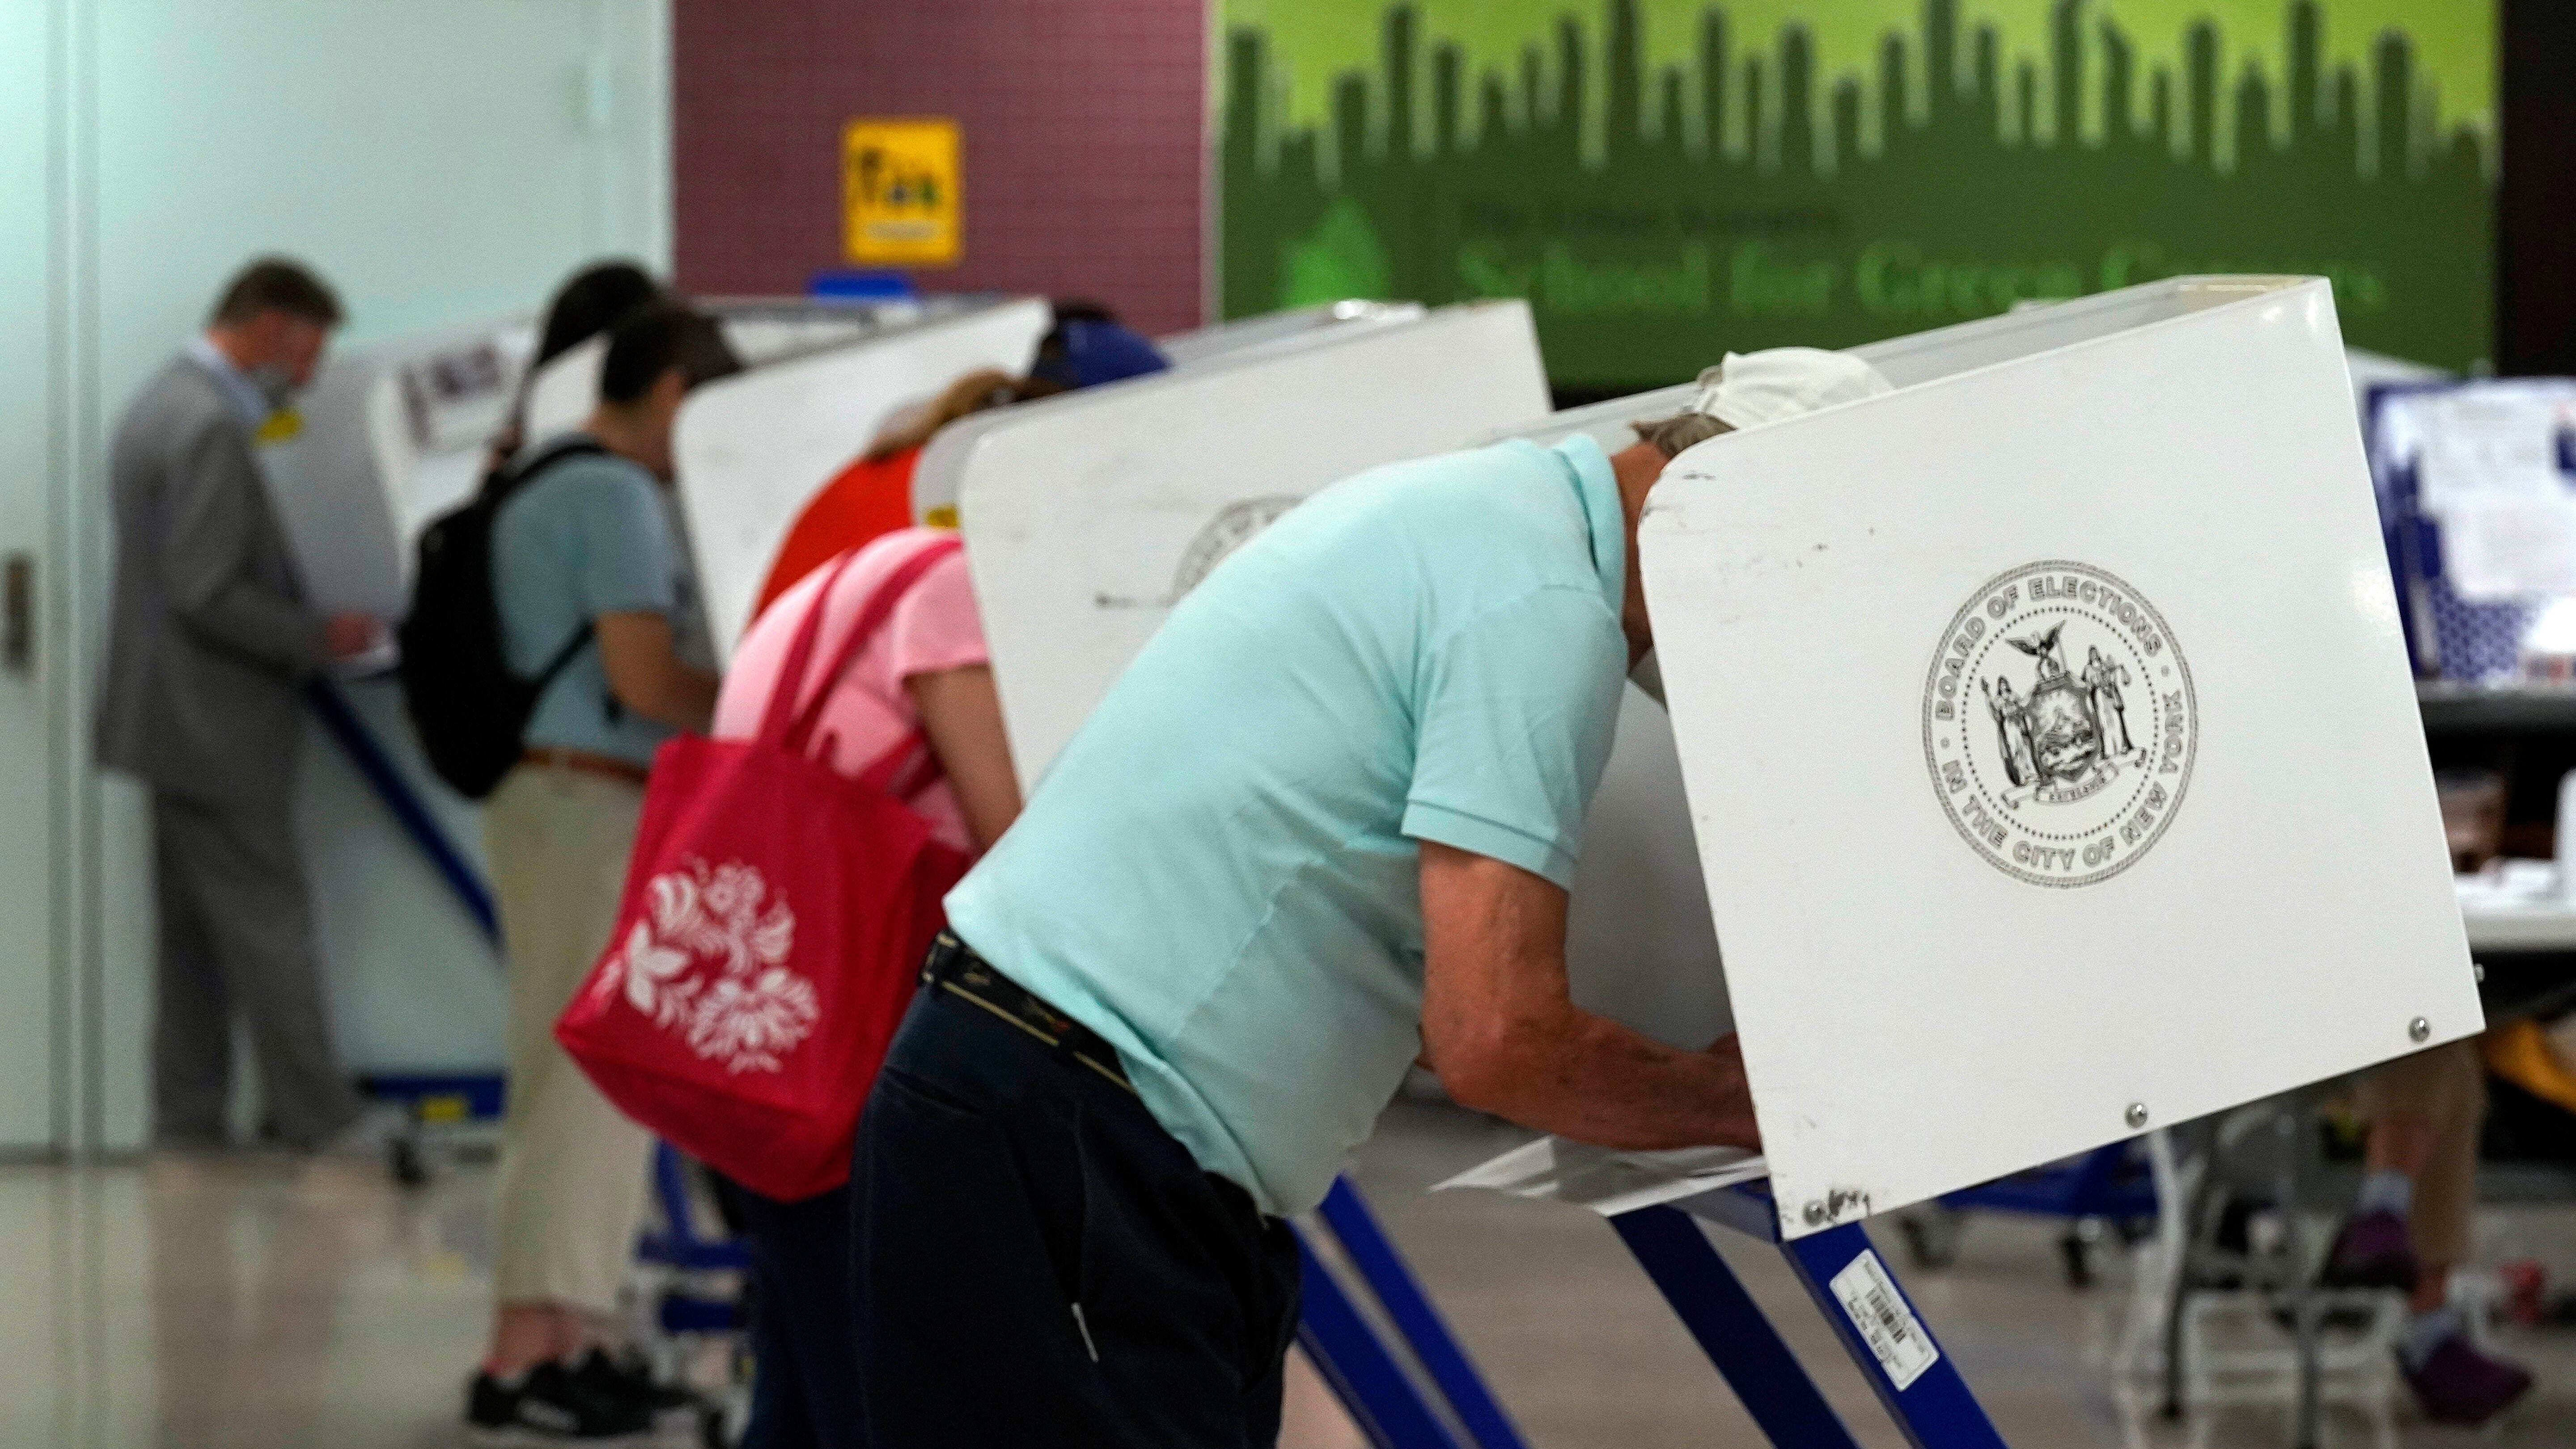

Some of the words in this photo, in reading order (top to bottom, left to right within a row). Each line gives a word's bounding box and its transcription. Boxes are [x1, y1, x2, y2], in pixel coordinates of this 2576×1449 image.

[1935, 616, 1986, 721] BOARD
[1987, 584, 2018, 621] OF
[2027, 576, 2163, 657] ELECTIONS
[1942, 759, 1968, 794] IN
[1962, 793, 2008, 849] THE
[2012, 840, 2076, 871] CITY
[2082, 835, 2115, 868] OF
[2119, 781, 2168, 847] NEW
[2159, 690, 2183, 774] YORK
